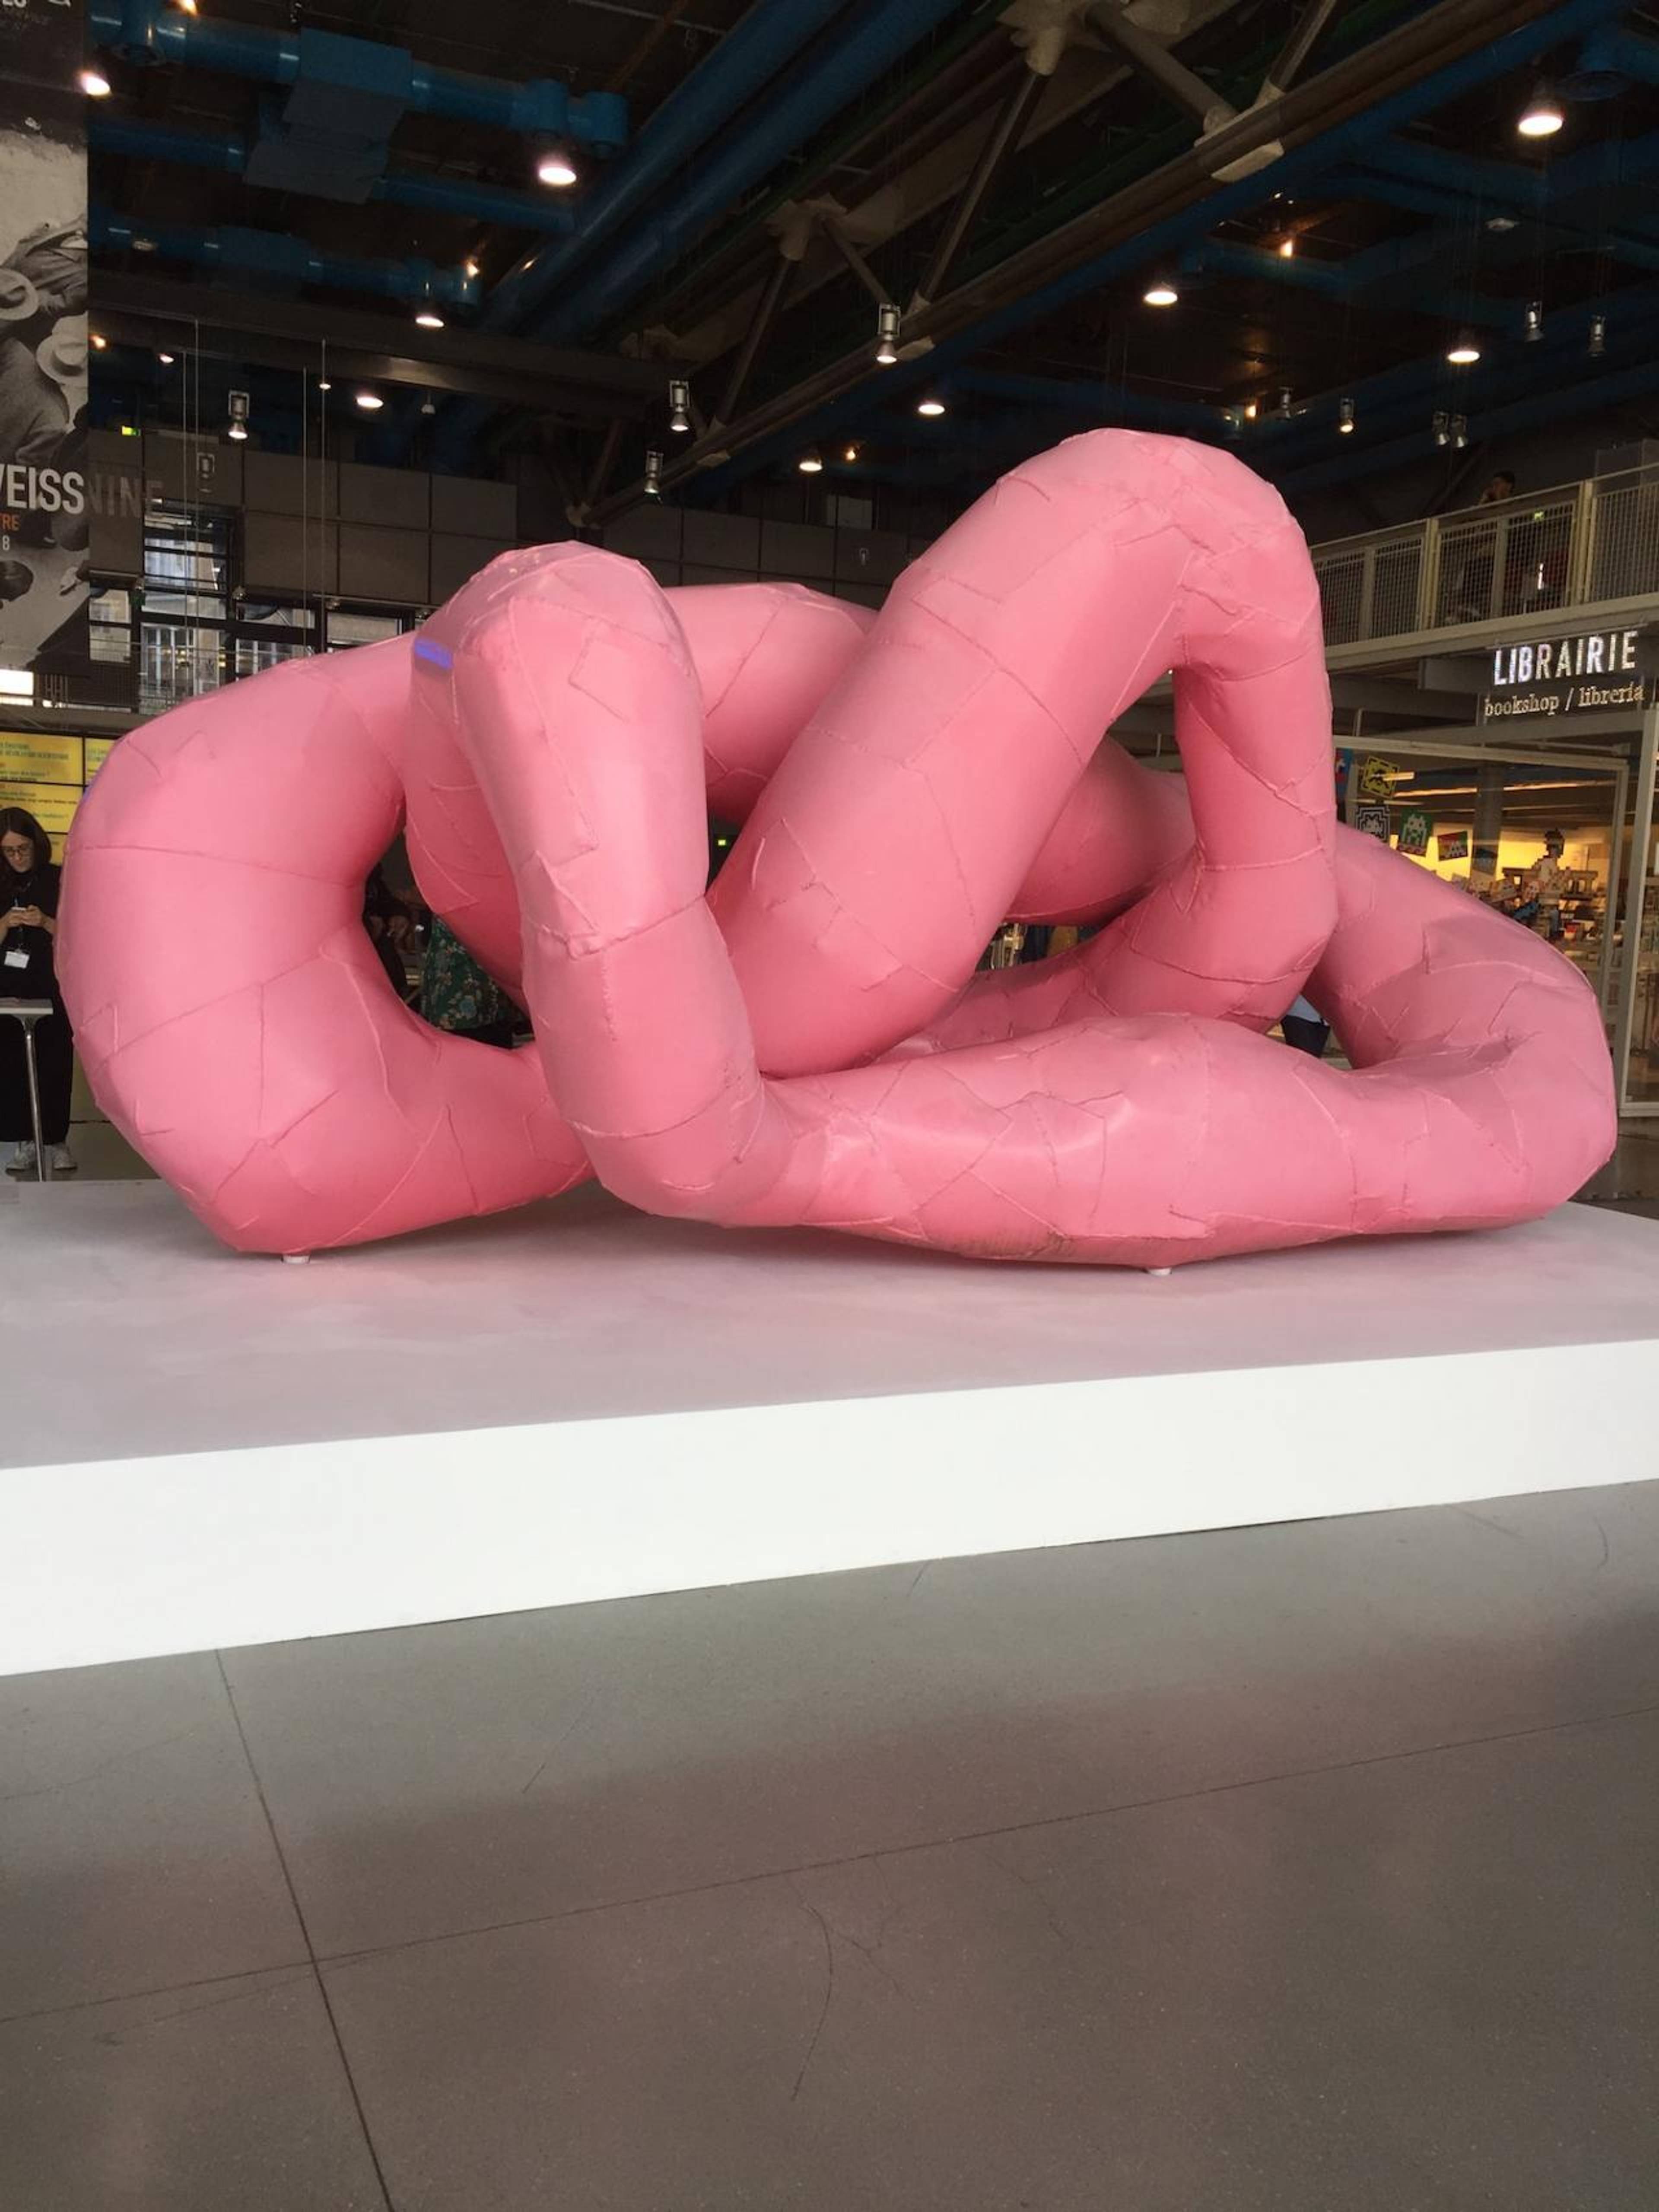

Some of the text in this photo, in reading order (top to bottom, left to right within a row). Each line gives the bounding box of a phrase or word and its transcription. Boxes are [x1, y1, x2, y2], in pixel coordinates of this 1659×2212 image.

[0, 463, 84, 514] EISS
[1494, 631, 1639, 685] LIBRAIRIE
[1485, 694, 1559, 717] bookshop
